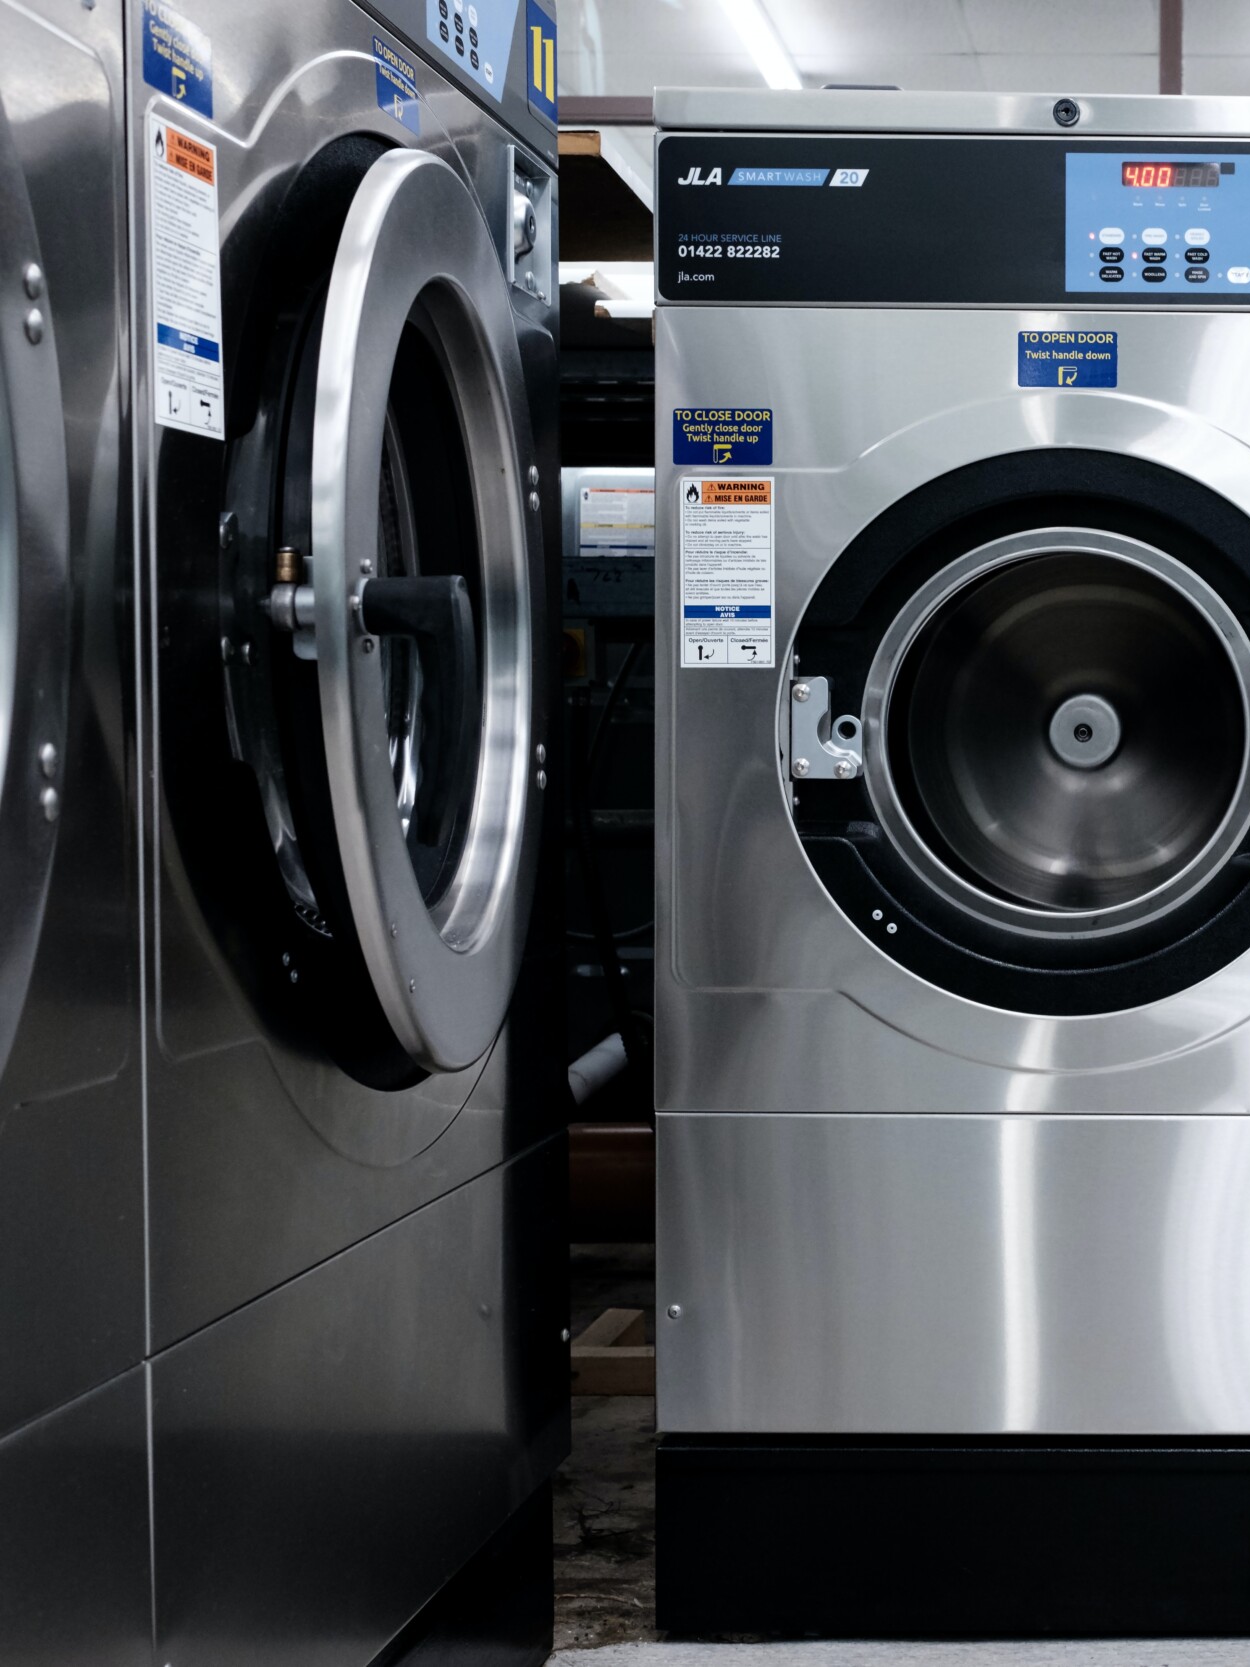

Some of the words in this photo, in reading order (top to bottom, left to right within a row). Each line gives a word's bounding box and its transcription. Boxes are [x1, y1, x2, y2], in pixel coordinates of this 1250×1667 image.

[374, 38, 383, 55] TO
[383, 46, 398, 67] OPEN
[398, 58, 415, 82] DOOR
[530, 26, 555, 105] 11
[177, 137, 211, 162] WARNING
[677, 167, 722, 186] JLA
[839, 171, 859, 184] 20
[1125, 166, 1172, 187] 4.00
[678, 233, 689, 242] 24
[690, 233, 719, 243] HOUR
[720, 234, 758, 243] SERVICE
[761, 234, 782, 243] LINE
[678, 245, 723, 258] 01422
[726, 246, 780, 258] 822282
[677, 271, 715, 283] jla.com
[1021, 333, 1039, 344] TO
[1041, 333, 1075, 344] OPEN
[1077, 333, 1114, 344] DOOR
[1025, 350, 1050, 360] Twist
[1051, 350, 1084, 360] handle
[1085, 350, 1111, 360] down
[675, 410, 690, 421] TO
[691, 410, 732, 421] CLOSE
[736, 411, 771, 422] DOOR
[682, 423, 713, 434] Gently
[714, 423, 739, 433] close
[740, 424, 763, 433] door
[686, 433, 712, 442] Twist
[713, 433, 745, 443] handle
[747, 435, 759, 445] up
[717, 483, 765, 491] WARNING
[714, 494, 735, 502] MISE
[736, 494, 743, 502] EN
[744, 494, 768, 503] GARDE
